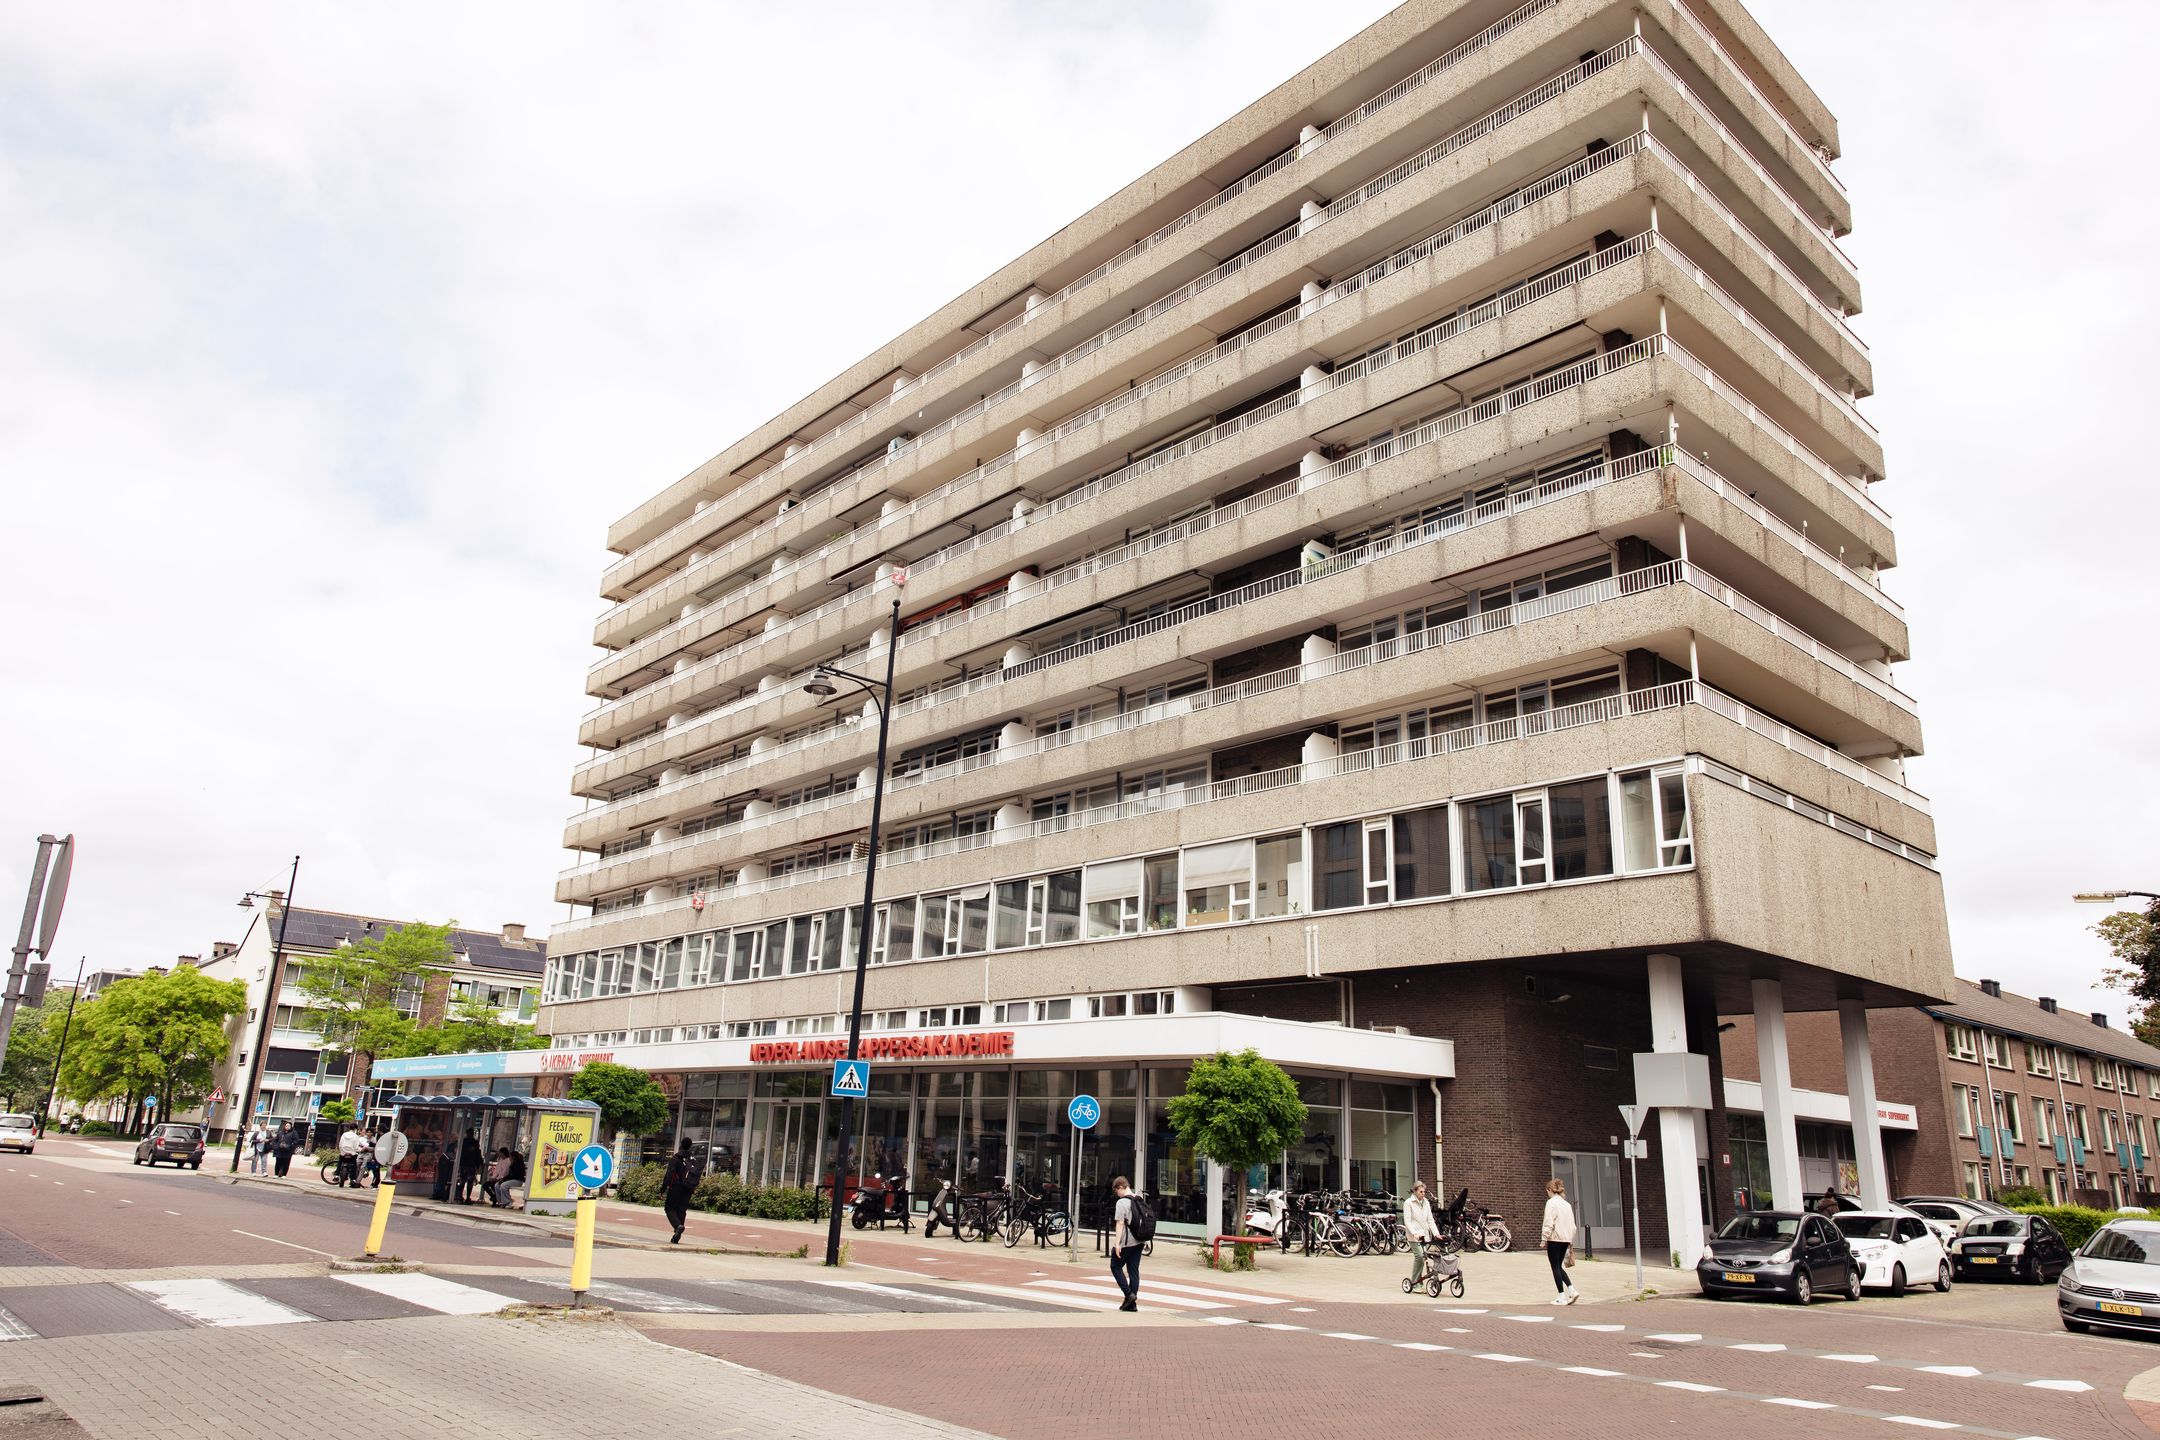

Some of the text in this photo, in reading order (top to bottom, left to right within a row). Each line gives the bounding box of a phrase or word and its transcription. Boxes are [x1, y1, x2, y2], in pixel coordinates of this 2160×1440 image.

[750, 1031, 1015, 1062] NEDERLANDSE APPERSAKADEMIE
[549, 1054, 574, 1070] IKRAM
[549, 1121, 569, 1132] FEEST
[554, 1133, 583, 1144] QMUSIC
[540, 1148, 577, 1168] FOUT
[2104, 1304, 2135, 1314] 1-XLK-13
